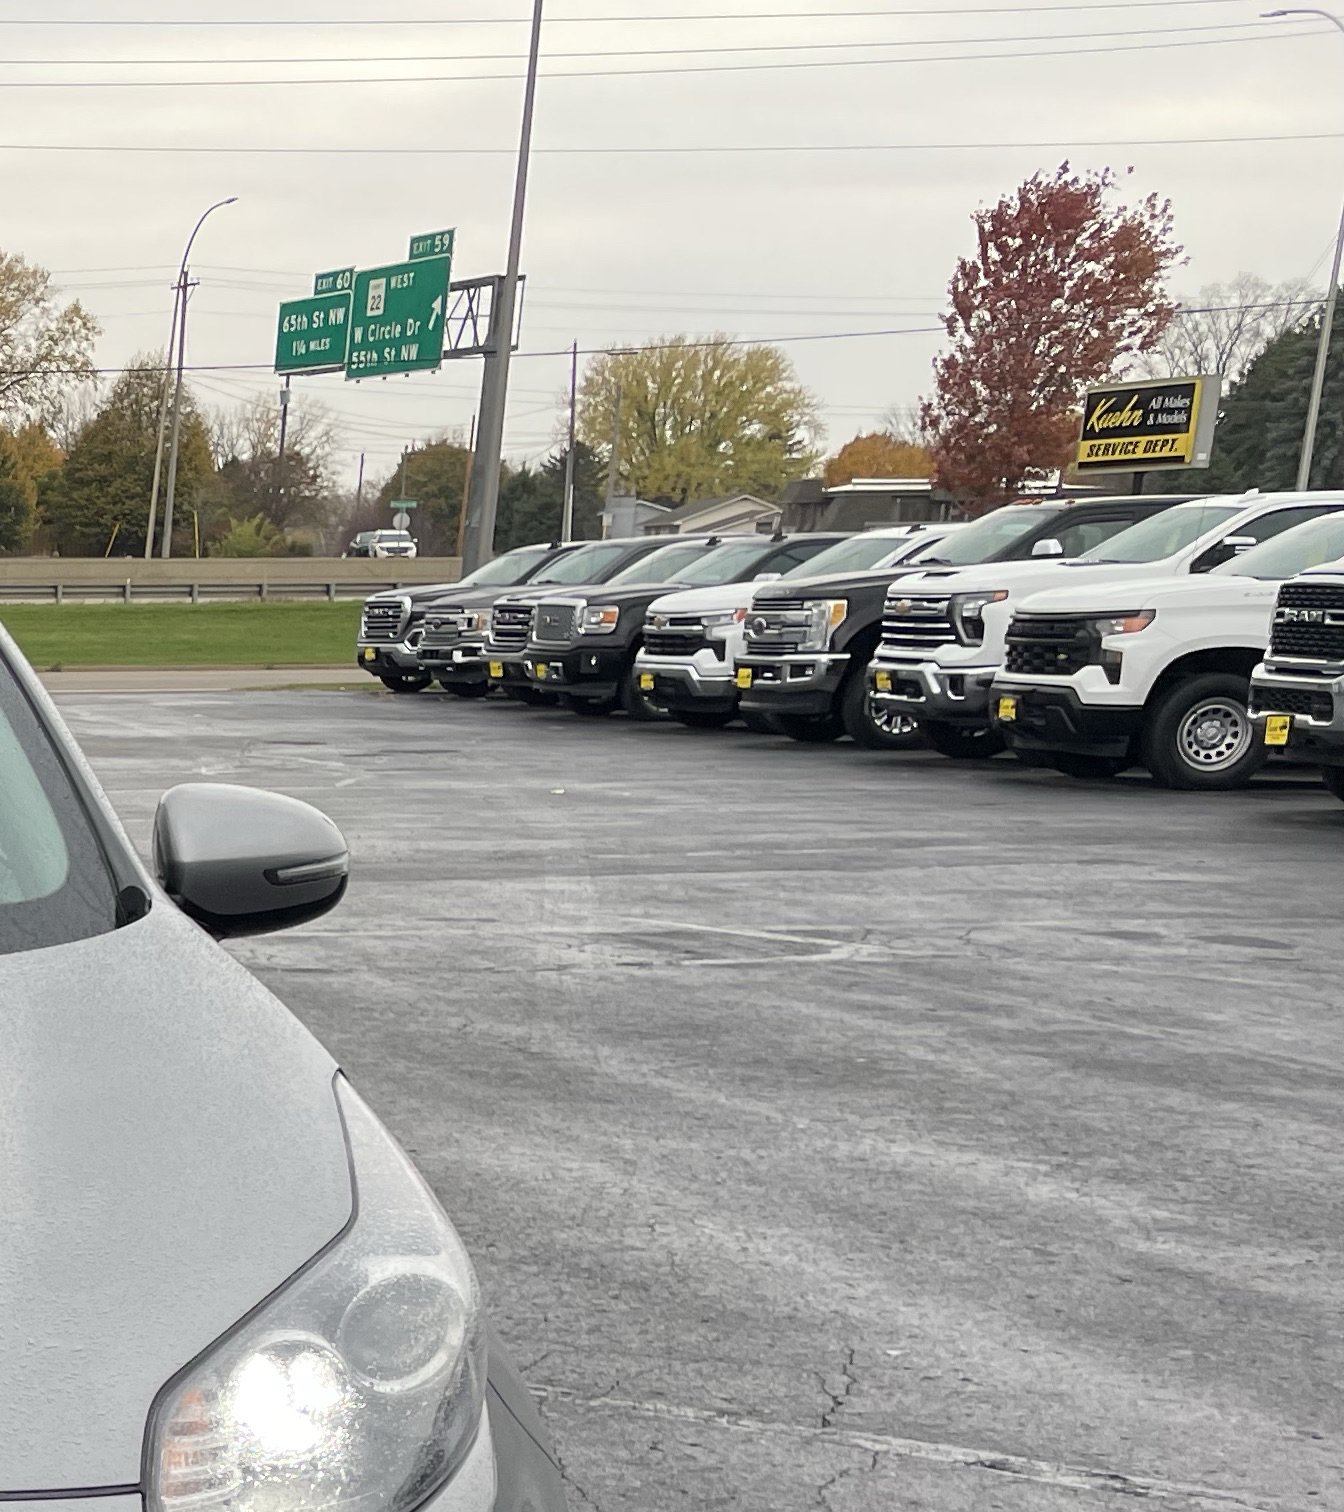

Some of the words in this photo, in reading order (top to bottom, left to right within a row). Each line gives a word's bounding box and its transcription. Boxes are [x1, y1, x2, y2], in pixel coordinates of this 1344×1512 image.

[413, 240, 432, 254] EXIT
[434, 233, 450, 252] 59
[317, 276, 334, 290] EXIT
[336, 271, 351, 289] 60
[390, 272, 415, 290] WEST
[370, 294, 382, 311] 22
[282, 314, 308, 333] 65th
[312, 310, 325, 328] St
[328, 307, 346, 325] NW
[354, 326, 363, 344] W
[368, 321, 401, 342] Circle
[406, 318, 421, 337] Dr
[309, 338, 331, 351] MILES
[351, 350, 378, 369] 55th
[384, 347, 396, 365] St
[400, 343, 419, 361] NW
[1148, 397, 1162, 410] All
[1163, 395, 1191, 409] Makes
[1086, 394, 1144, 433] Kuehn
[1146, 413, 1155, 426] &
[1156, 410, 1188, 424] Models
[1087, 440, 1141, 458] SERVICE
[1143, 437, 1178, 454] DEPT.
